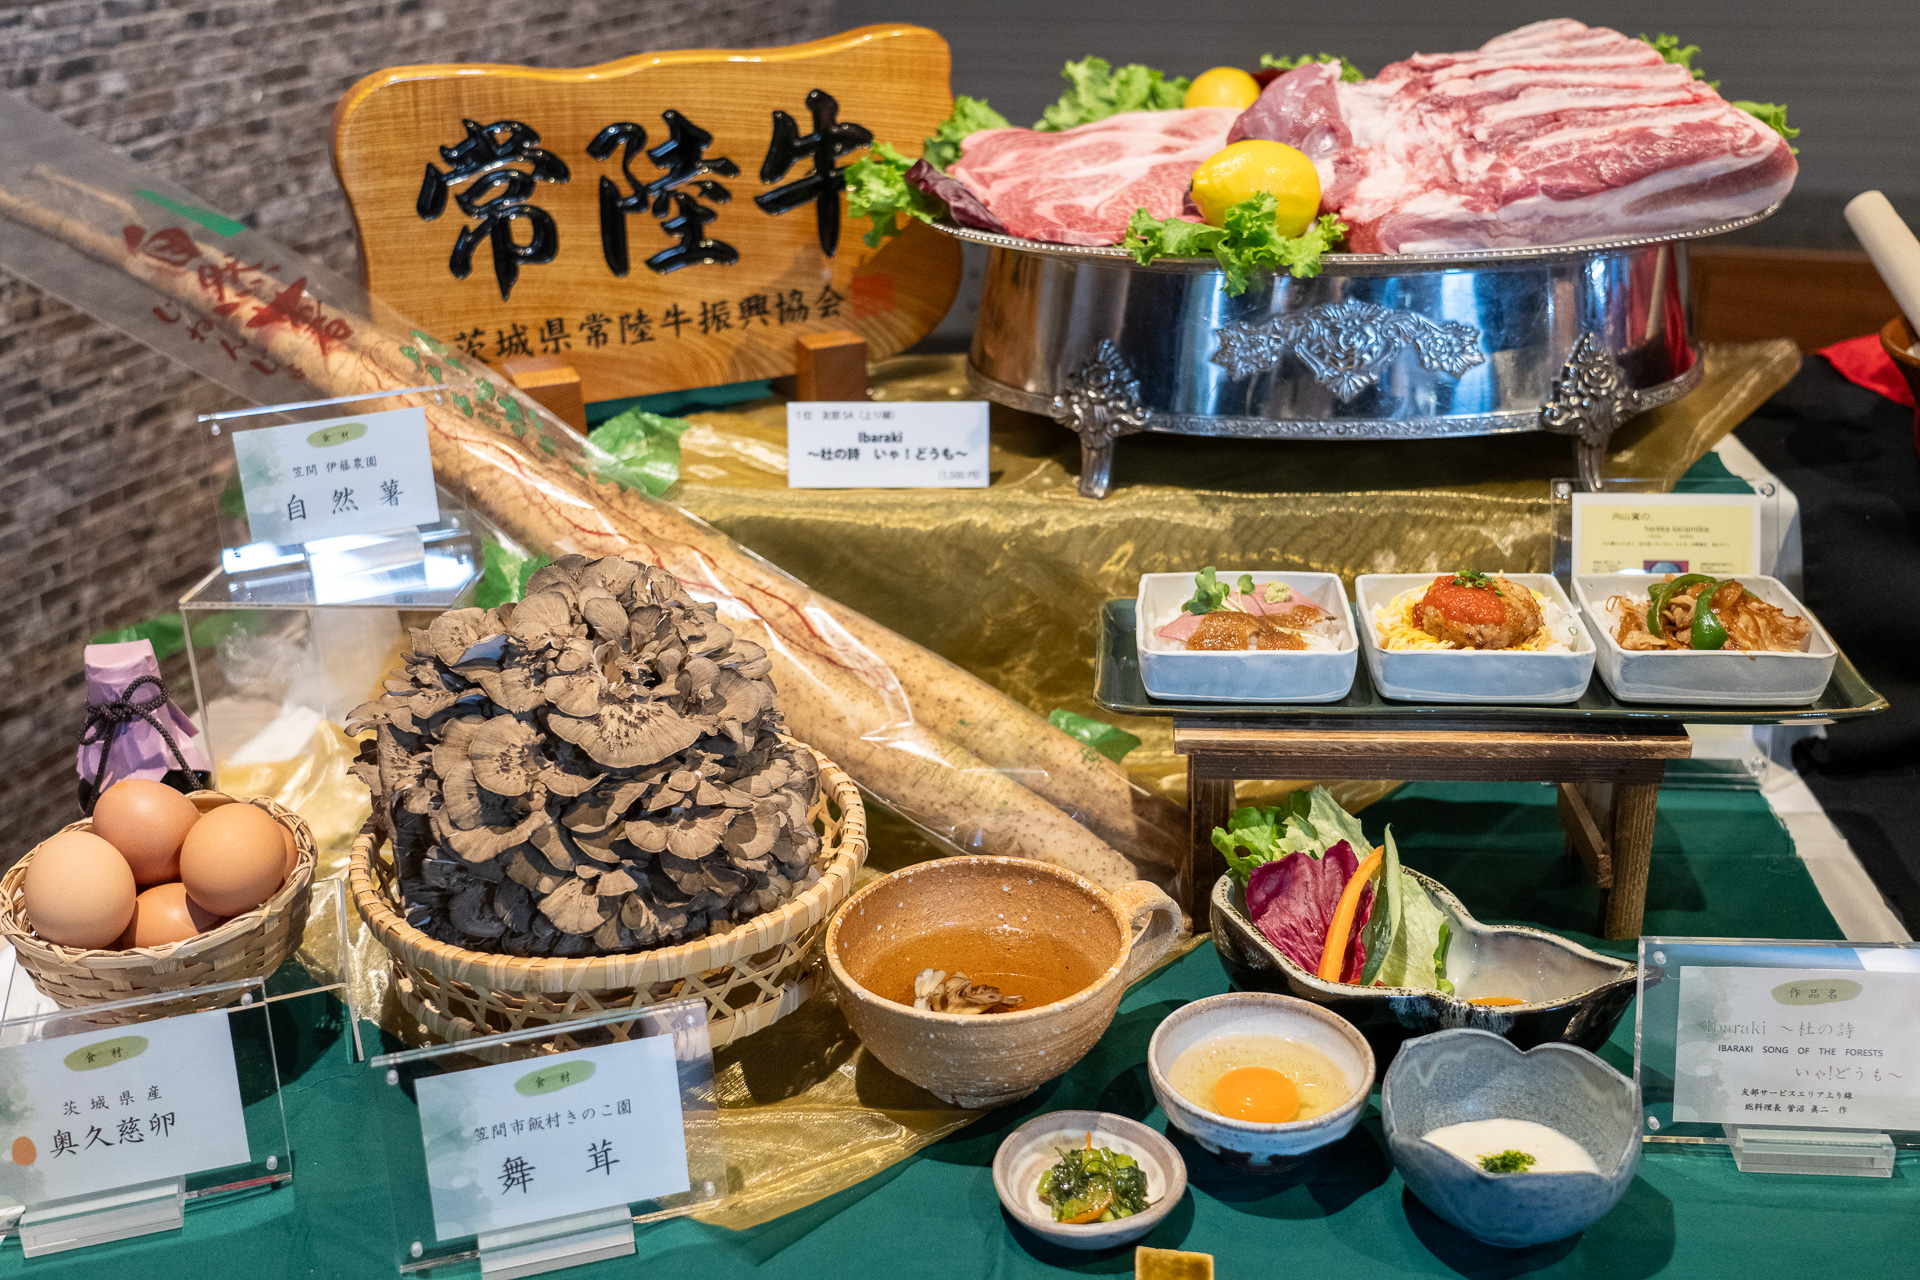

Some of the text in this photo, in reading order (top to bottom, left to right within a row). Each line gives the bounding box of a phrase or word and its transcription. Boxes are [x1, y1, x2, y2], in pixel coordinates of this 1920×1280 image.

[416, 89, 873, 302] 常陸牛
[454, 285, 846, 364] 茨城県常陸牛振興協会
[858, 431, 903, 443] Ibaraki
[293, 455, 378, 478] 笠間 伊藤農園
[287, 479, 404, 521] 自然薯
[1790, 987, 1838, 999] 作品名
[1706, 1020, 1766, 1035] Ibaraki
[84, 1047, 122, 1064] 食材
[1718, 1044, 1883, 1057] IBARAKI SONG OF THE FORESTS
[534, 1071, 571, 1089] 食材
[63, 1085, 162, 1117] 茨城県産
[473, 1098, 632, 1143] 笠間市飯村きのこ園
[50, 1111, 176, 1159] 奥久慈卵
[497, 1138, 620, 1195] 舞茸
